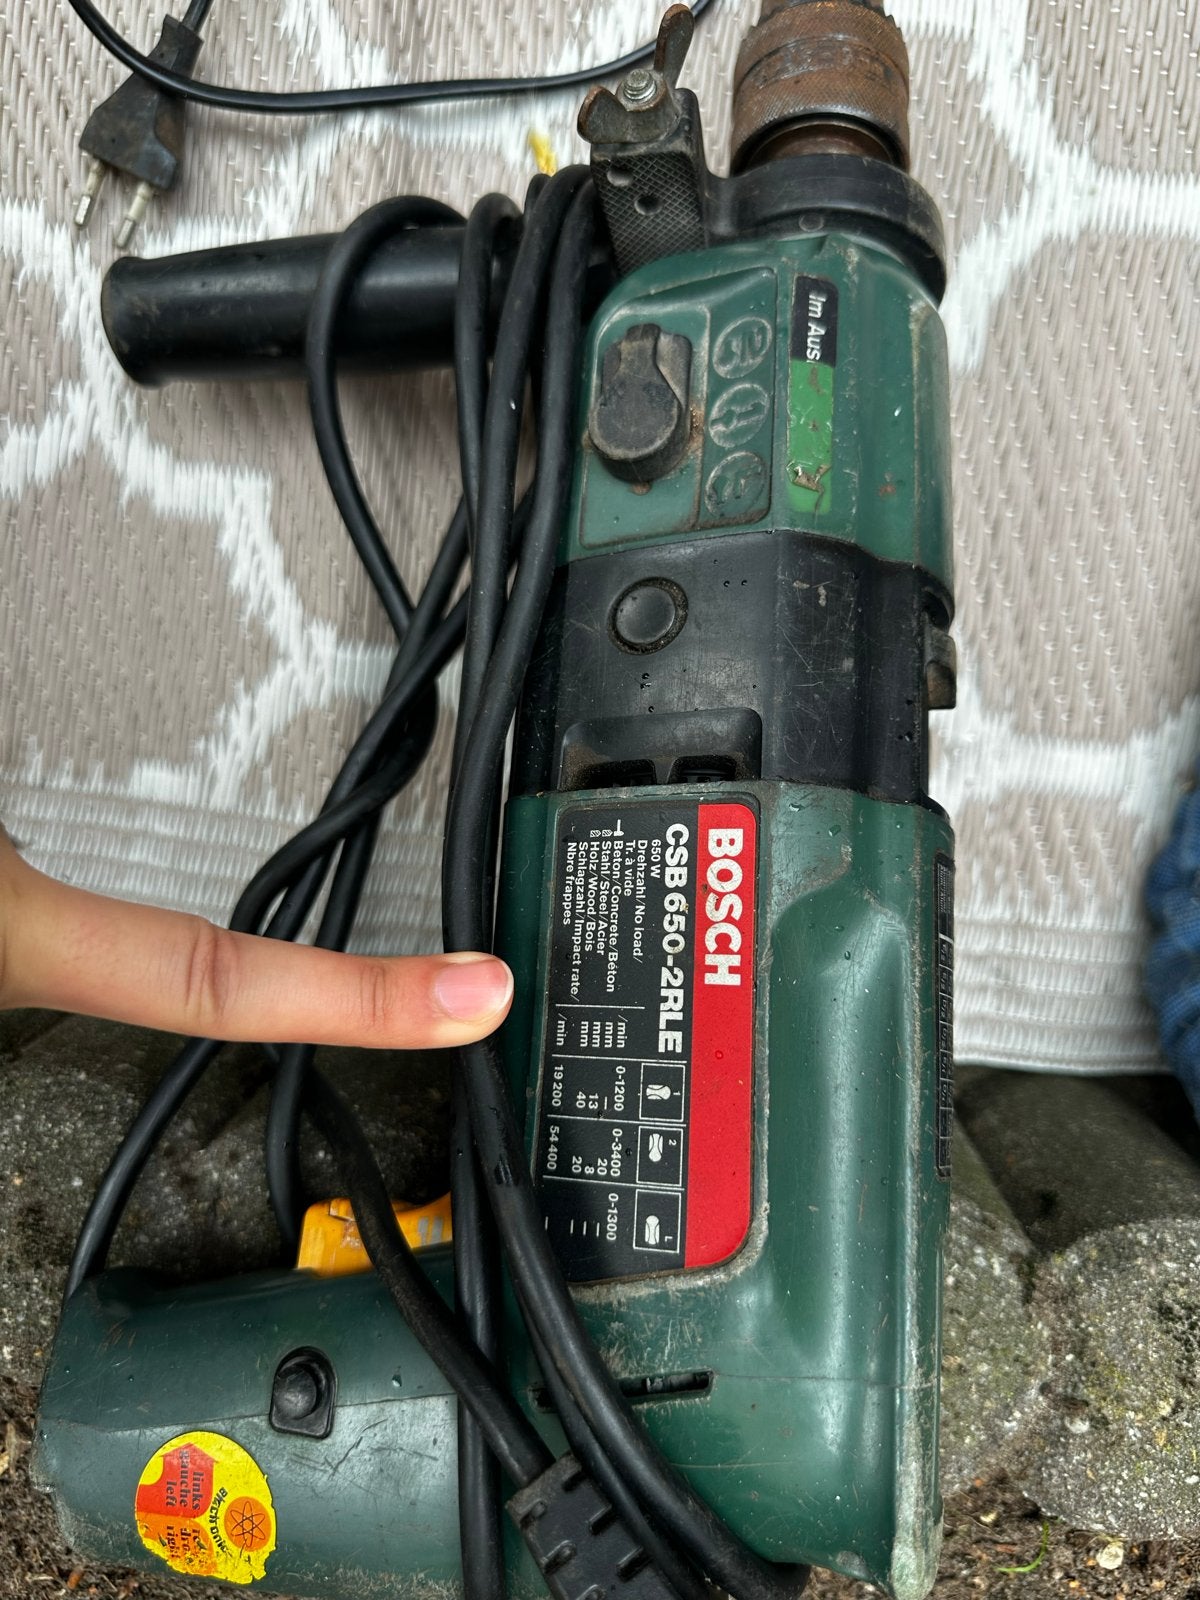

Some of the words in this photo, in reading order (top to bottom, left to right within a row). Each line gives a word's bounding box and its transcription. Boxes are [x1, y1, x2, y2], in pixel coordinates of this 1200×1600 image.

[809, 293, 827, 318] Im
[806, 322, 827, 363] Aus
[565, 842, 576, 873] Nbre
[625, 840, 635, 855] Tr.
[625, 858, 635, 866] à
[650, 839, 661, 862] 650
[664, 823, 689, 888] CSB
[624, 869, 634, 897] vide
[634, 839, 648, 924] Drehzahl/No
[650, 864, 660, 878] W
[562, 875, 574, 925] frappes
[572, 841, 588, 965] Schlagzahl/Impact
[584, 841, 600, 952] Holz/Wood/Bois
[596, 841, 611, 956] Stahl/Steel/Acier
[704, 828, 743, 986] BOSCH
[606, 841, 623, 992] Beton/Concrete/Béton
[633, 927, 643, 963] load/
[570, 968, 581, 1001] rate/
[658, 892, 689, 1053] 650-2RLE
[555, 1013, 568, 1046] /min
[580, 1021, 590, 1047] mm
[592, 1021, 602, 1047] mm
[604, 1021, 614, 1047] mm
[616, 1015, 628, 1048] /min
[553, 1065, 564, 1080] 19
[613, 1065, 625, 1111] 0-1200
[552, 1082, 562, 1107] 200
[576, 1091, 587, 1108] 40
[588, 1093, 599, 1109] 13
[549, 1125, 559, 1143] 54
[547, 1144, 558, 1170] 400
[572, 1156, 582, 1173] 20
[597, 1158, 608, 1175] 20
[610, 1128, 622, 1177] 0-3400
[585, 1166, 595, 1174] 8
[606, 1193, 619, 1240] 0-1300
[166, 1480, 177, 1508] left
[179, 1450, 191, 1508] gauche
[192, 1471, 204, 1510] links
